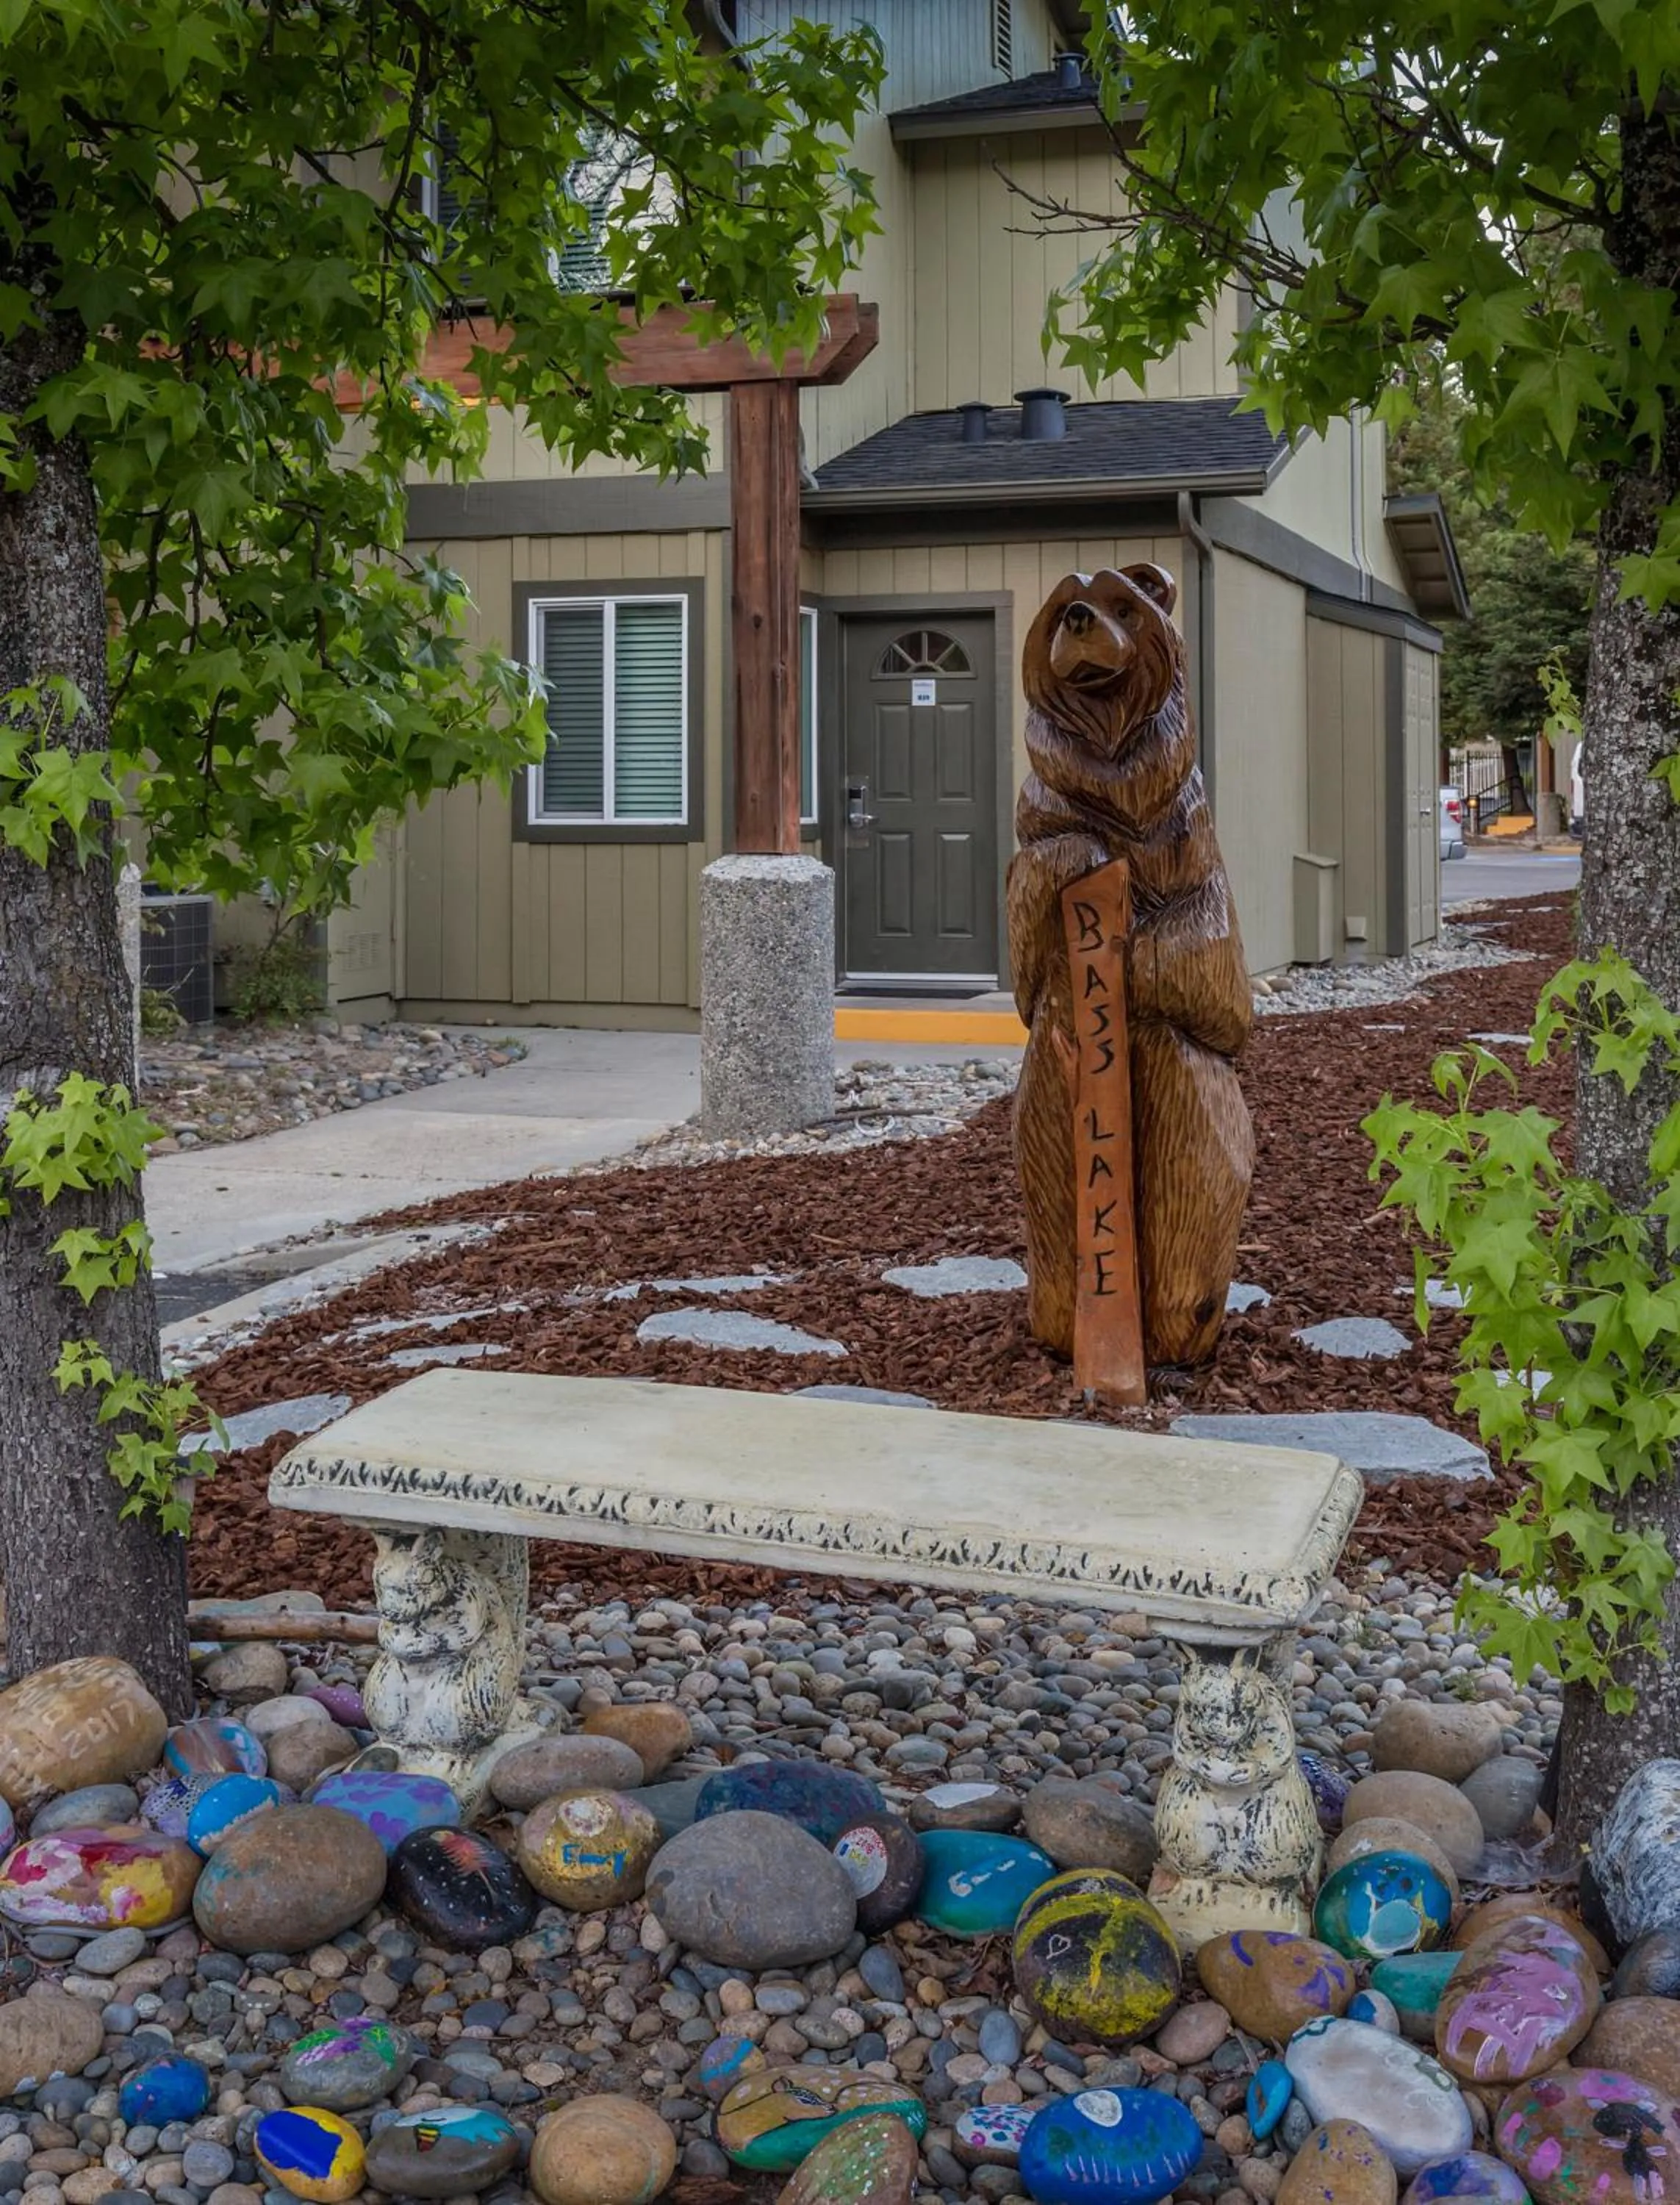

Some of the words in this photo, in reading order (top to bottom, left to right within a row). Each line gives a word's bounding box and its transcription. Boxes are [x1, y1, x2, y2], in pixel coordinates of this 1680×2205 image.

[1072, 901, 1116, 1075] BASS
[1085, 1108, 1117, 1296] LAKE
[61, 1699, 135, 1760] 2017
